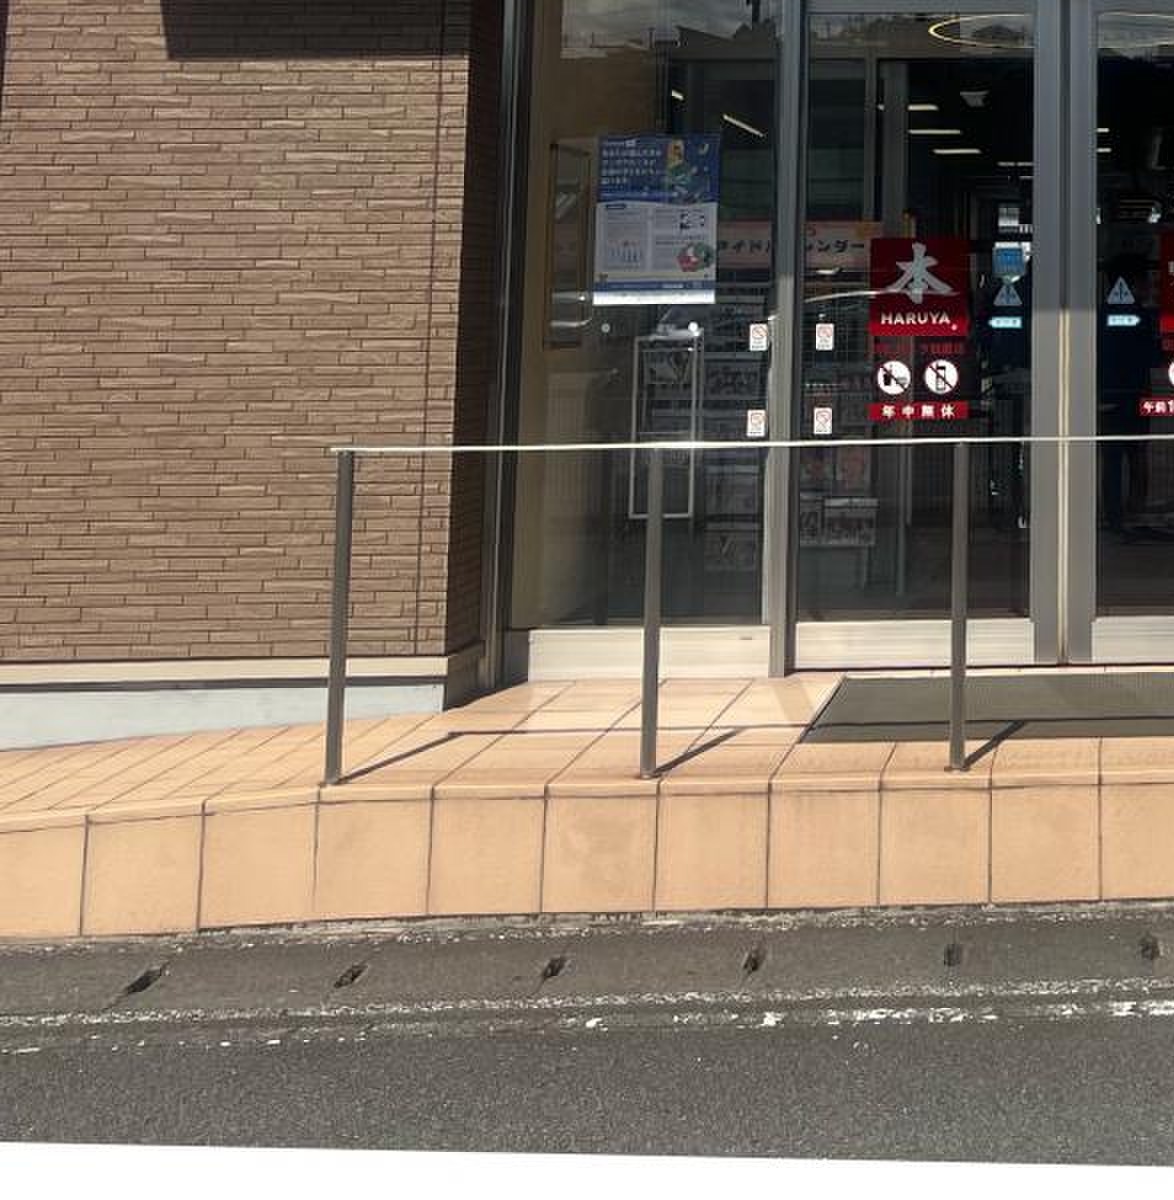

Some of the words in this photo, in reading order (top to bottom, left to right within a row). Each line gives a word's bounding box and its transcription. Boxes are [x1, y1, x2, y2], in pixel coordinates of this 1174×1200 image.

[884, 241, 959, 303] 本
[880, 311, 951, 326] HARUYA
[881, 403, 956, 419] 年中無休
